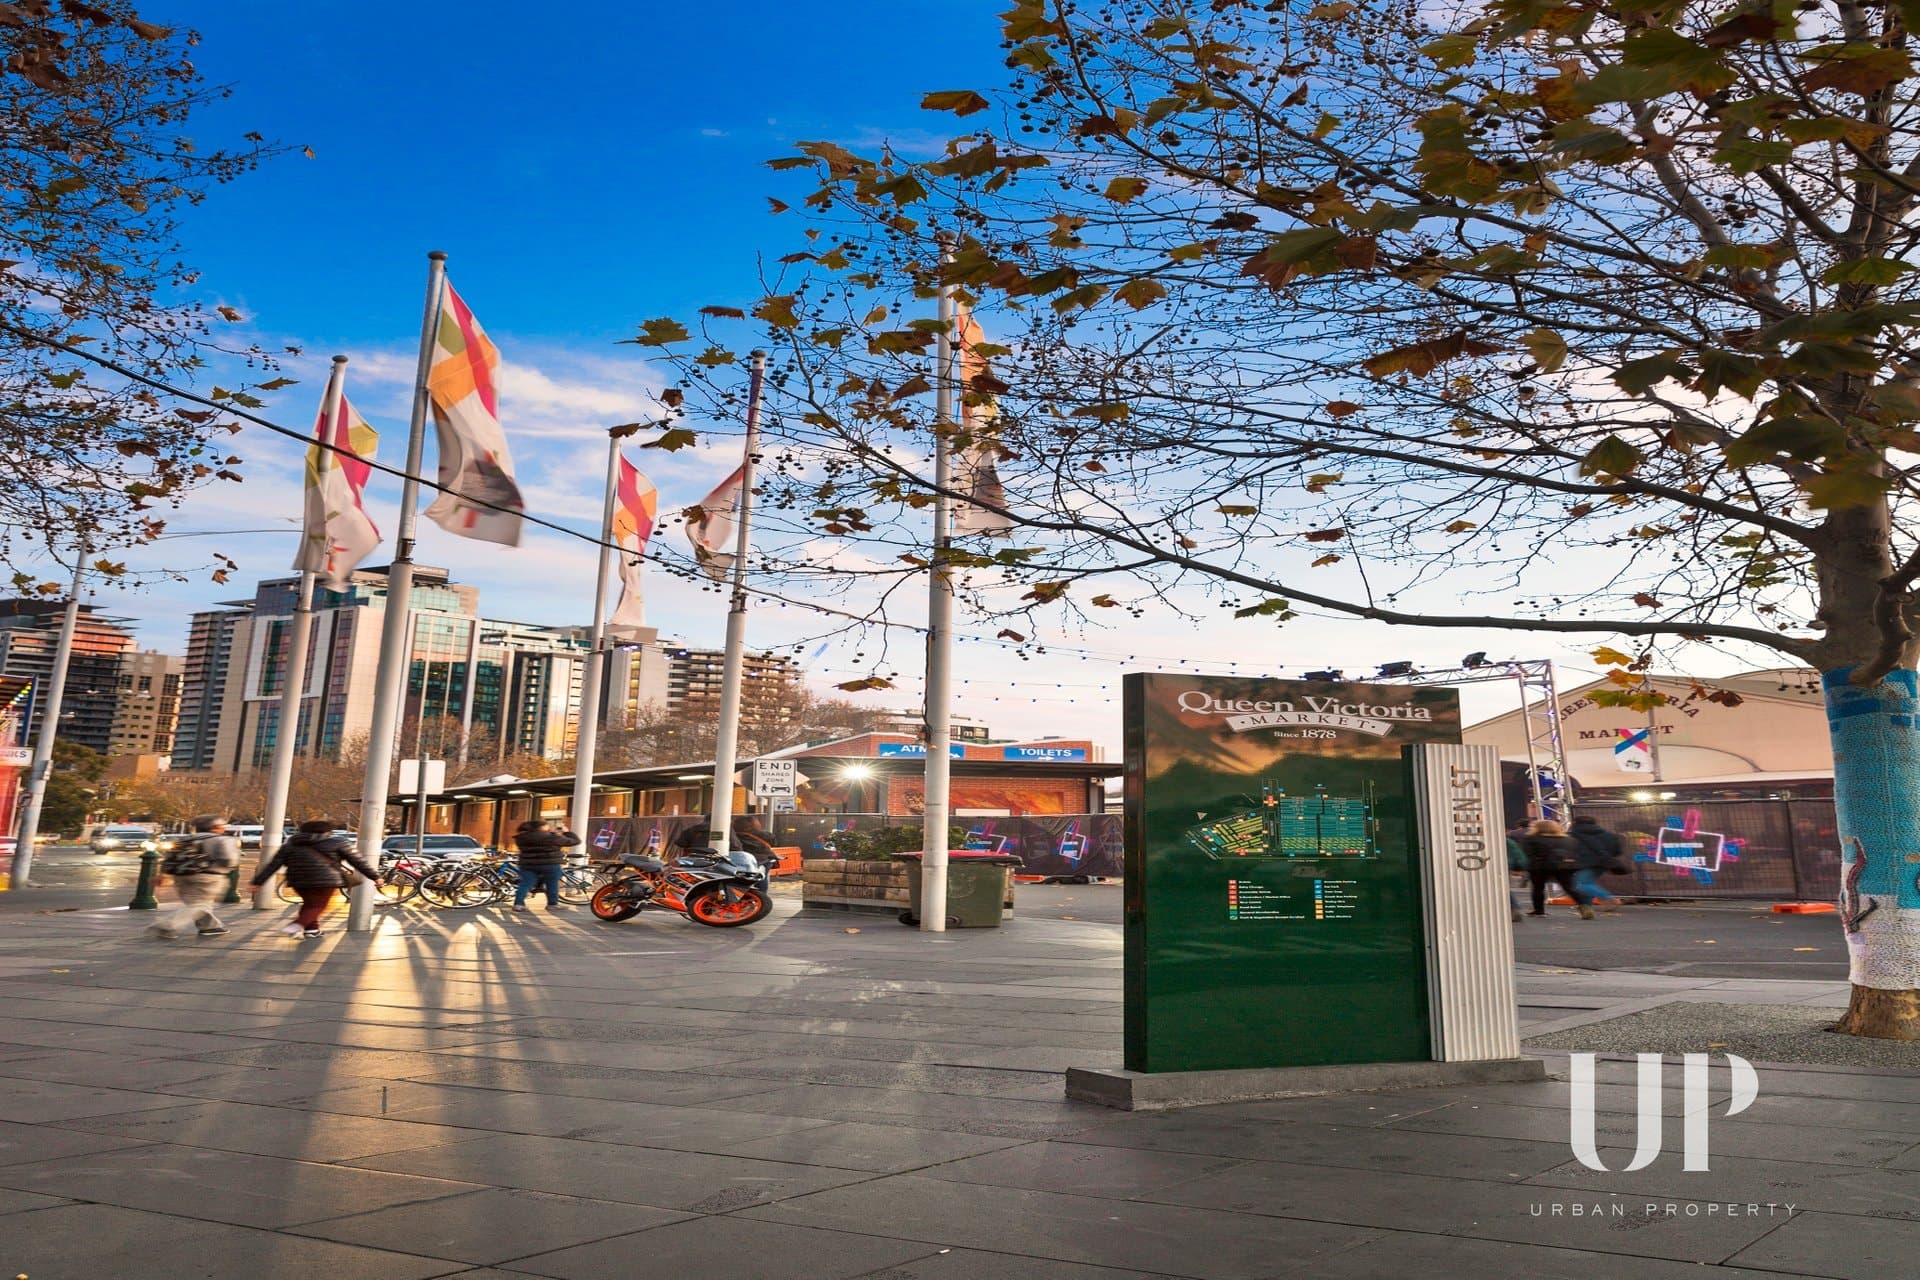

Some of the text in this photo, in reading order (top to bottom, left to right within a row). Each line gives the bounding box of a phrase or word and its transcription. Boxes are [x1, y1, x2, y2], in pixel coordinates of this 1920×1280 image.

[1177, 690, 1431, 718] Queen Victoria
[1250, 713, 1371, 730] MARKET
[1274, 729, 1337, 739] Since 1878
[1579, 725, 1674, 739] MAT
[1019, 748, 1073, 757] TOILETS
[759, 762, 792, 770] END
[1451, 765, 1490, 871] QUEEN ST
